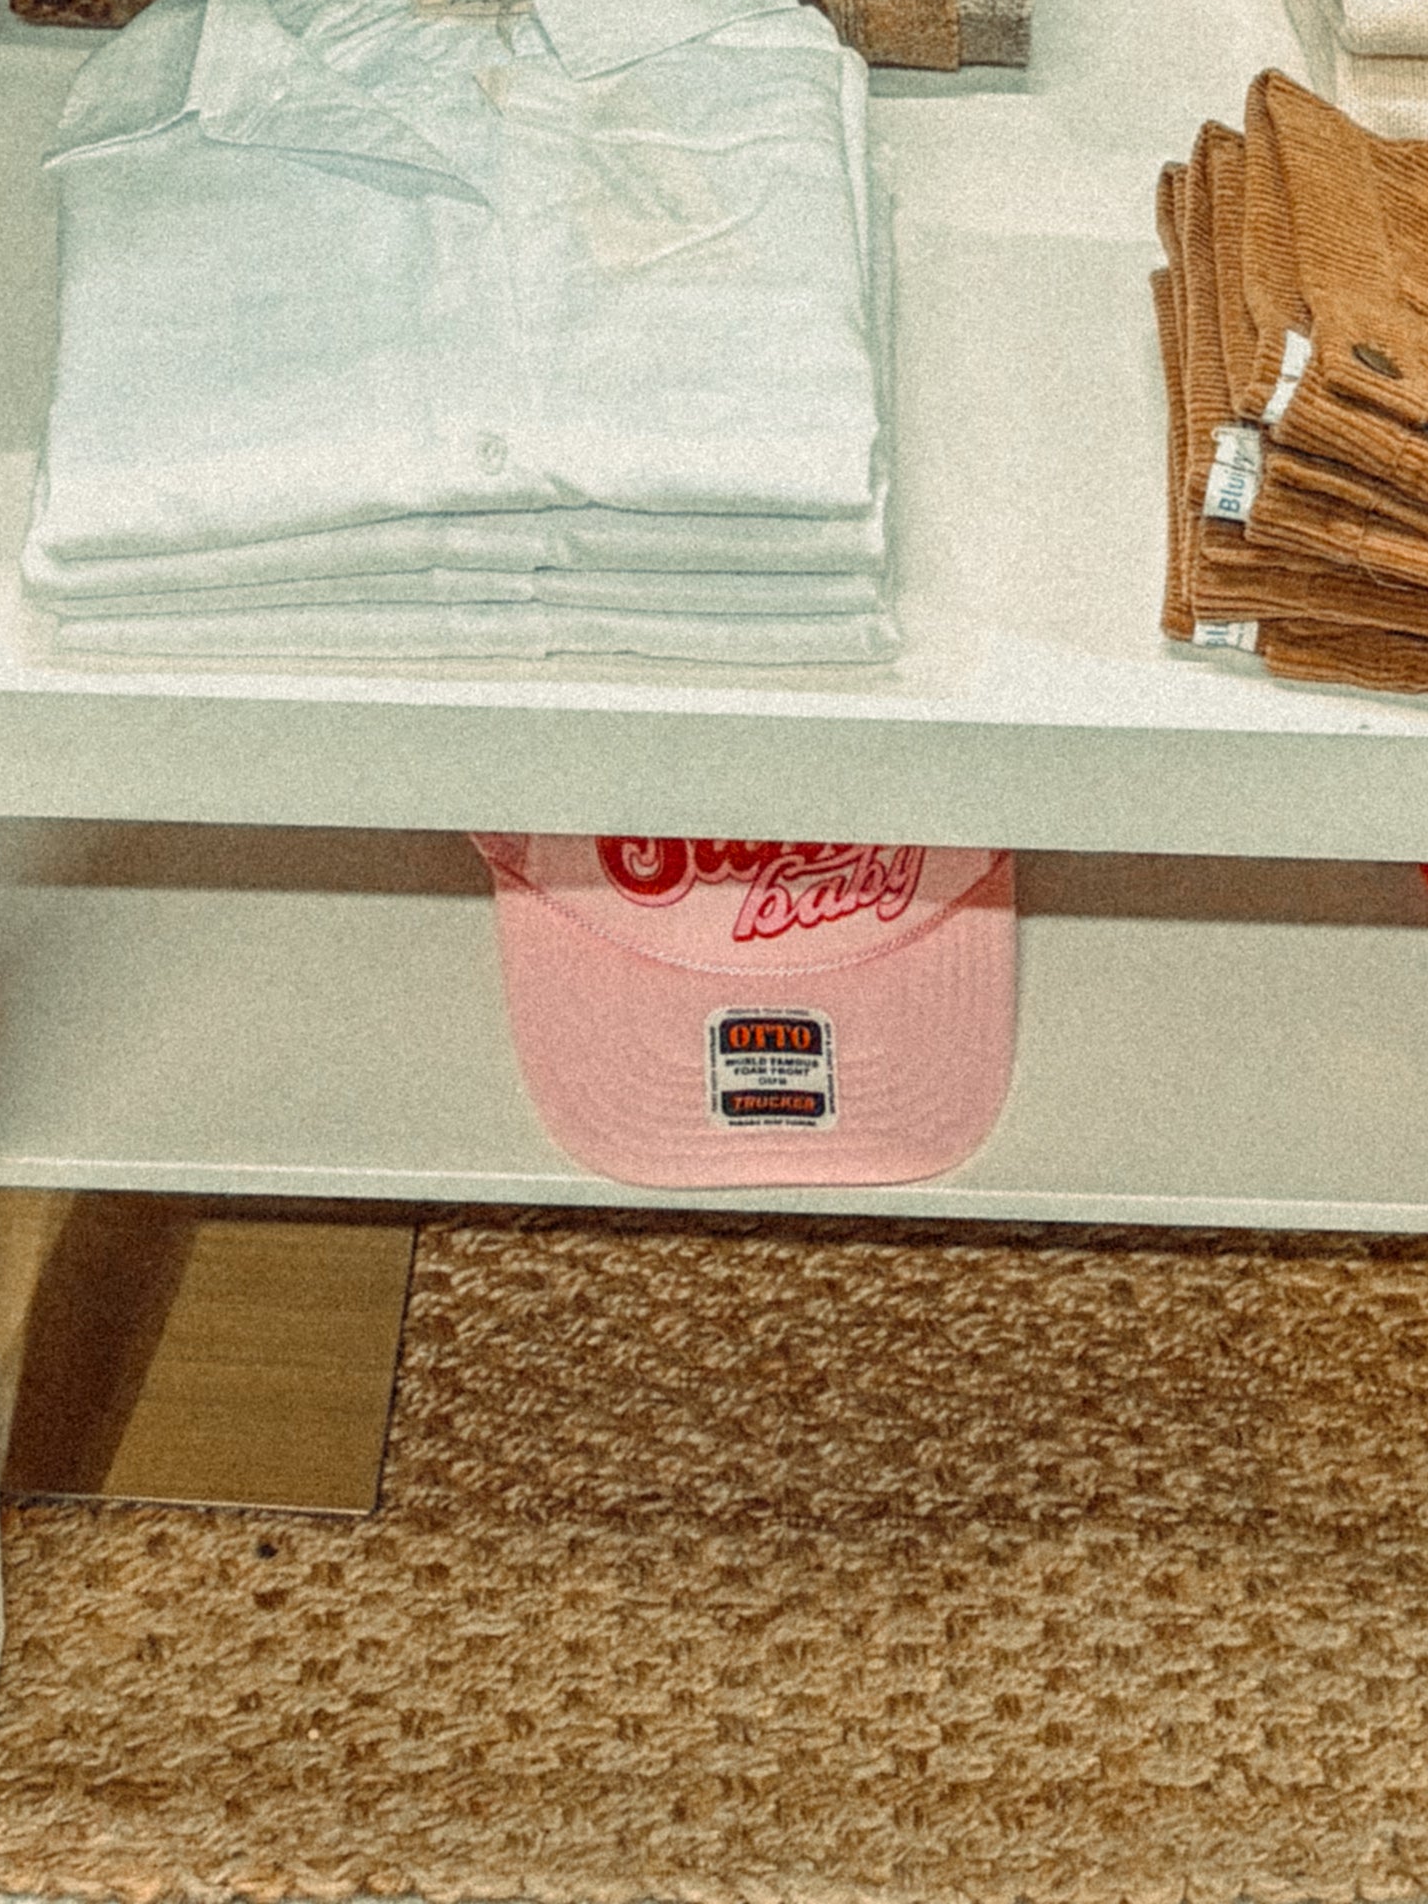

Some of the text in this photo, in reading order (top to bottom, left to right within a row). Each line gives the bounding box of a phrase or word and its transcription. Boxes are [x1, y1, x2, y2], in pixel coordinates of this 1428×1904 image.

[731, 845, 926, 942] baby
[728, 1024, 812, 1050] OTTO
[731, 1095, 817, 1111] TRUCKER
